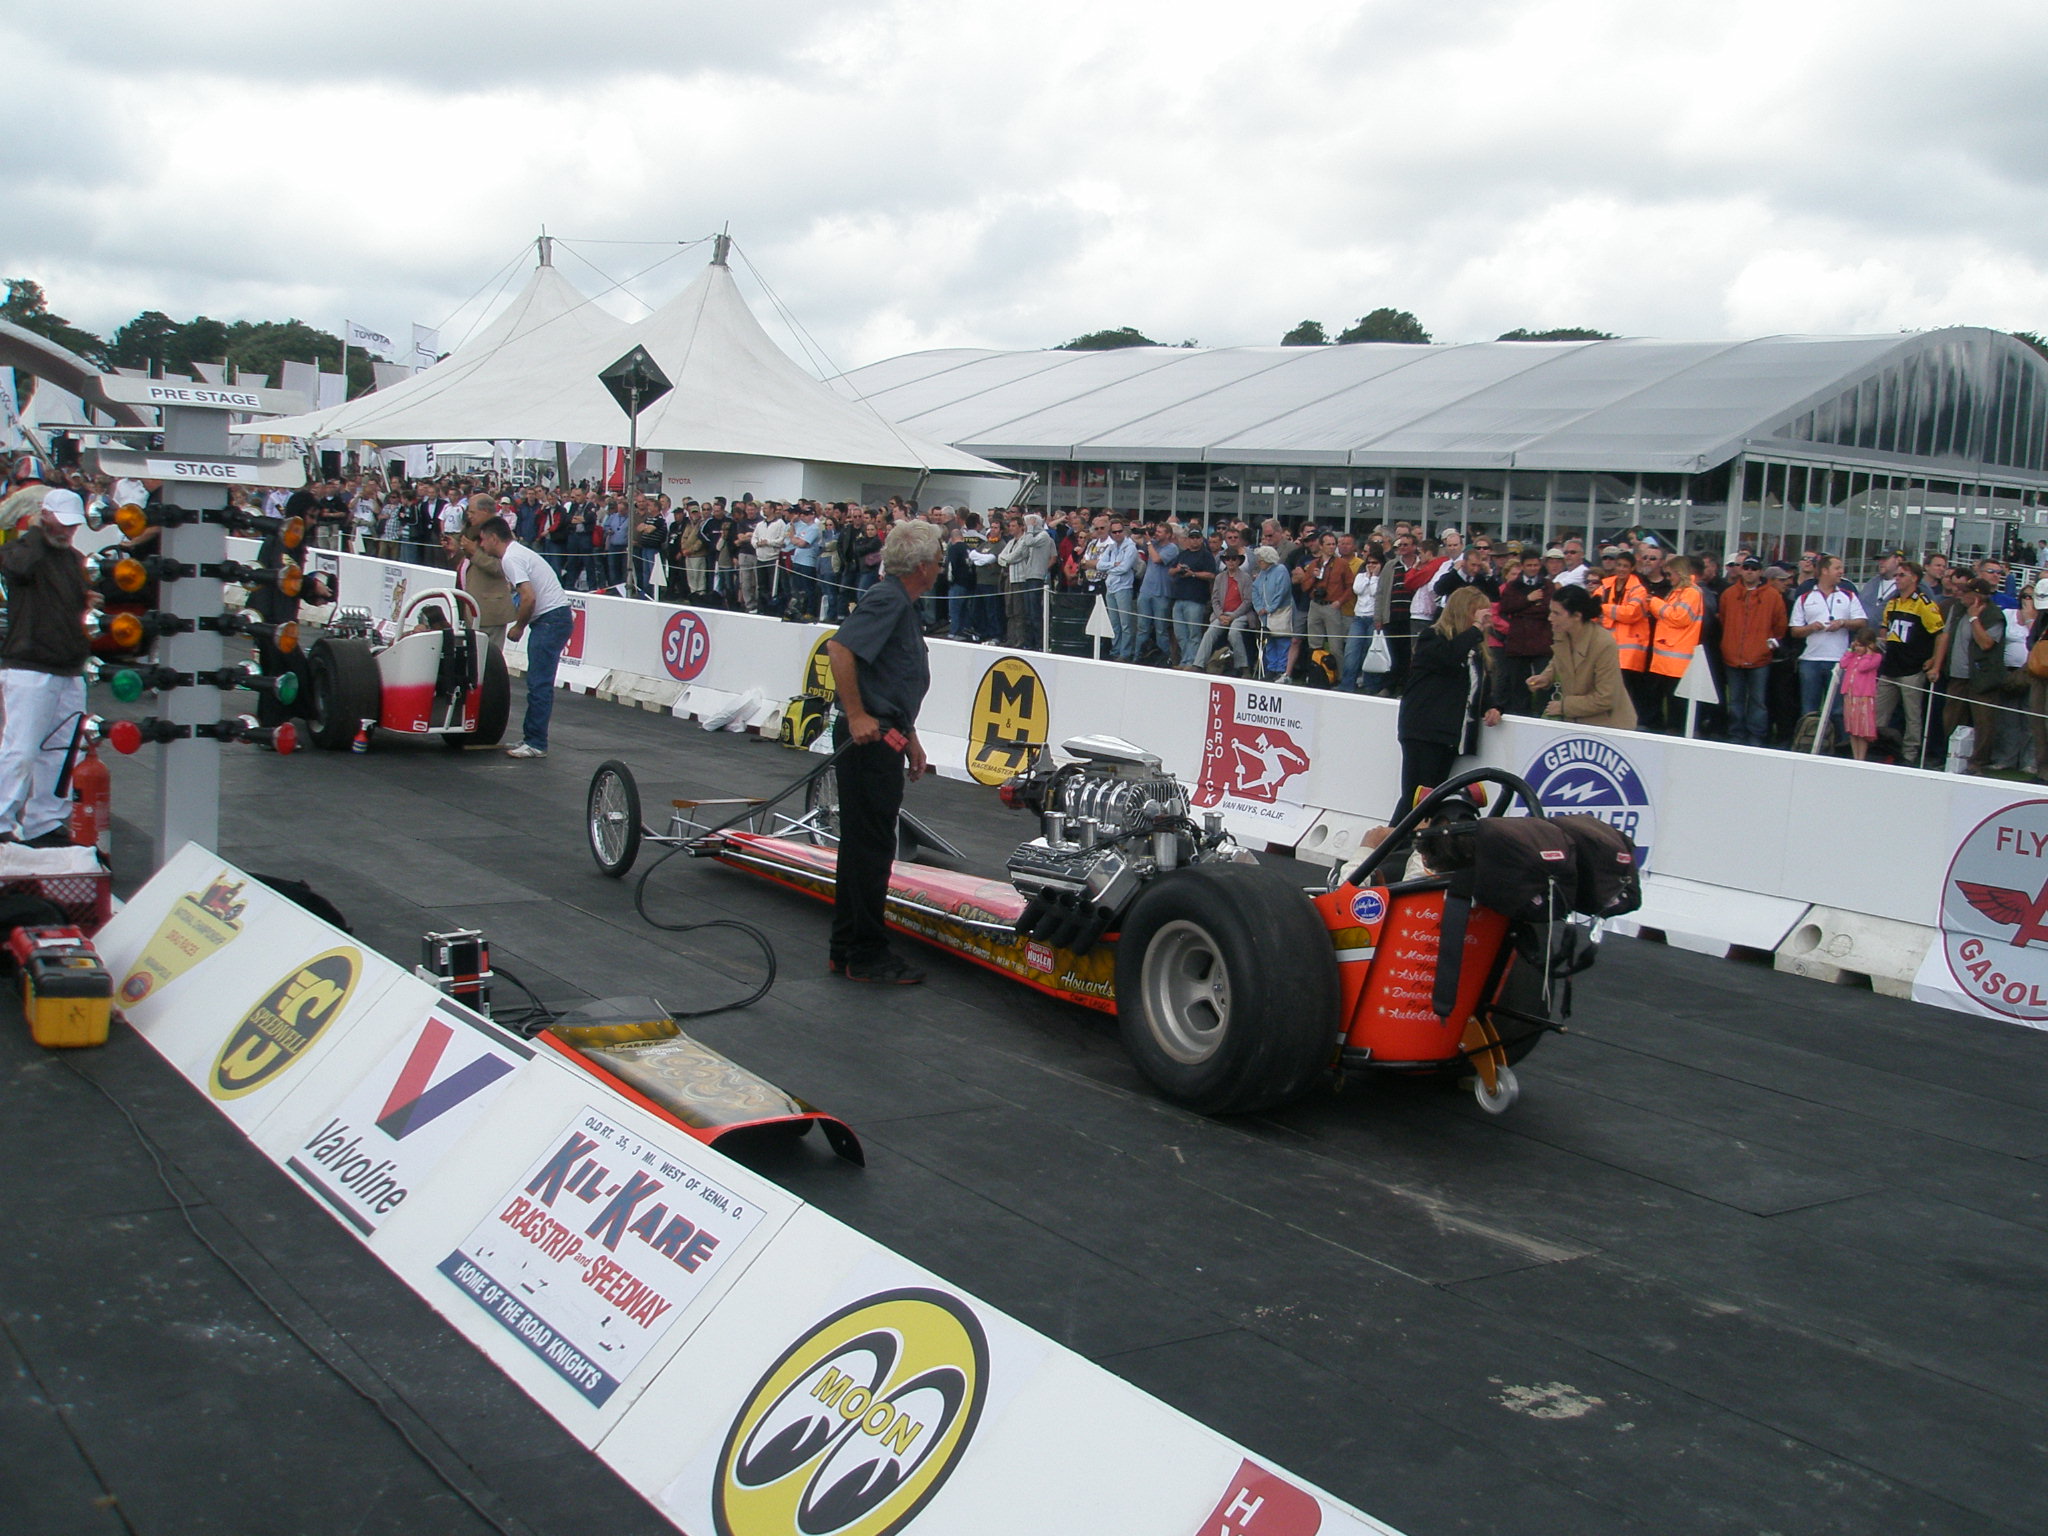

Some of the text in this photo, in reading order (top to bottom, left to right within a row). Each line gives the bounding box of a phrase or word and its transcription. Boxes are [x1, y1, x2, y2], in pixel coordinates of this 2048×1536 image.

[353, 329, 391, 345] TOYOTA
[151, 386, 260, 408] PRE STAGE
[174, 461, 238, 478] STAGE
[668, 477, 692, 485] TOYOTA
[1887, 619, 1913, 643] AT
[666, 619, 704, 671] STP
[808, 687, 834, 703] SPEED
[990, 670, 1035, 720] M
[1247, 693, 1282, 713] B&M
[1005, 719, 1012, 728] &
[1211, 690, 1224, 759] HYDRO
[1236, 712, 1303, 730] AUTOMOTIVE INC.
[975, 722, 1029, 769] H
[971, 762, 1014, 777] RACEMASTER
[1203, 739, 1216, 805] STICK
[1543, 740, 1630, 782] GENUINE
[1222, 800, 1284, 821] VAN NUYS, CALIF.
[1416, 907, 1440, 921] Joe
[1410, 930, 1440, 946] Kenn
[1061, 971, 1115, 998] Howards
[1396, 968, 1435, 982] Ashla
[1391, 985, 1433, 1000] Donov
[250, 1007, 308, 1054] SPEEDWELL
[304, 1117, 408, 1214] Valvoline
[585, 1116, 744, 1220] OLD RT. 35, 3 MI. WEST OF XENIA, O.
[499, 1195, 672, 1330] DRAGSTRIP and SPEEDWAY
[454, 1261, 602, 1390] HOME OF THE ROAD KNIGHTS
[810, 1365, 923, 1456] MOON
